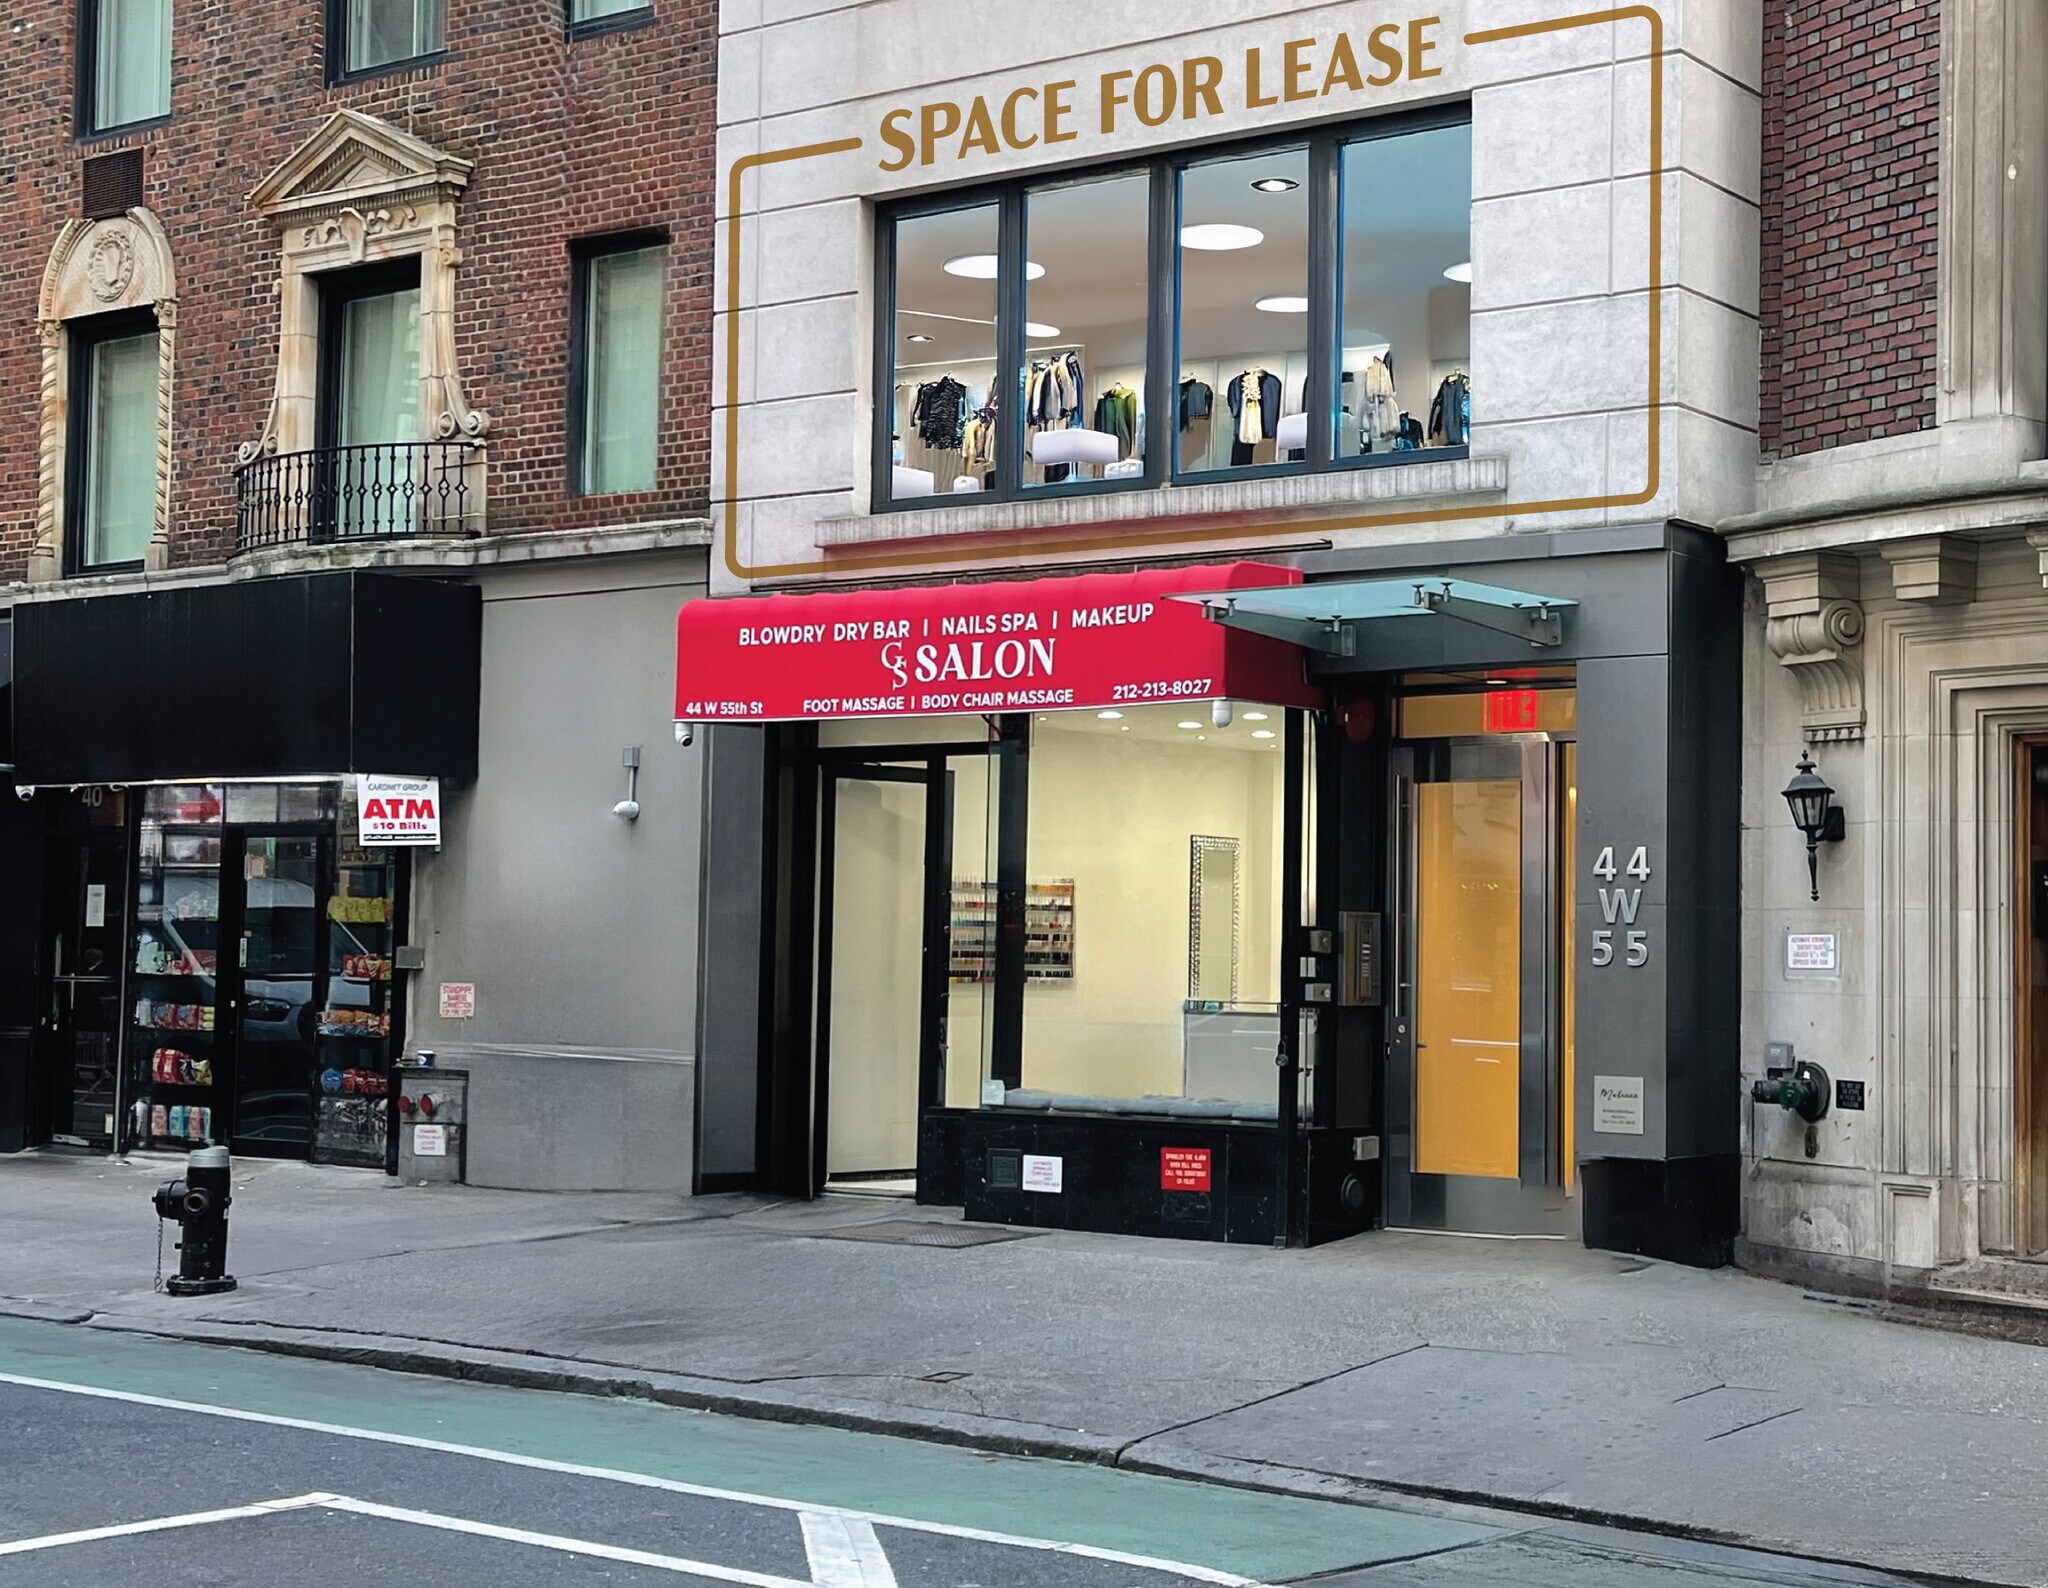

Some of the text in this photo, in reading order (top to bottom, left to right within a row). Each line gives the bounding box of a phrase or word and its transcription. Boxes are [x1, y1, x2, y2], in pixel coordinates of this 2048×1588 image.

[941, 610, 1039, 636] NAILS SPA
[1071, 602, 1155, 629] MAKEUP
[738, 619, 911, 646] BLOWDRY DRY BAR
[914, 637, 1056, 683] SALON
[921, 688, 1074, 709] BODY CHAIR MASSAGE
[1112, 678, 1213, 700] 212-213-8027
[685, 701, 763, 715] 44 W 55th St
[803, 696, 905, 713] FOOT MASSAGE
[81, 786, 102, 808] 40
[363, 798, 435, 819] ATM
[373, 822, 427, 830] $10 Bills
[1592, 846, 1650, 882] 44
[1598, 888, 1642, 924] W
[1592, 930, 1649, 967] 55
